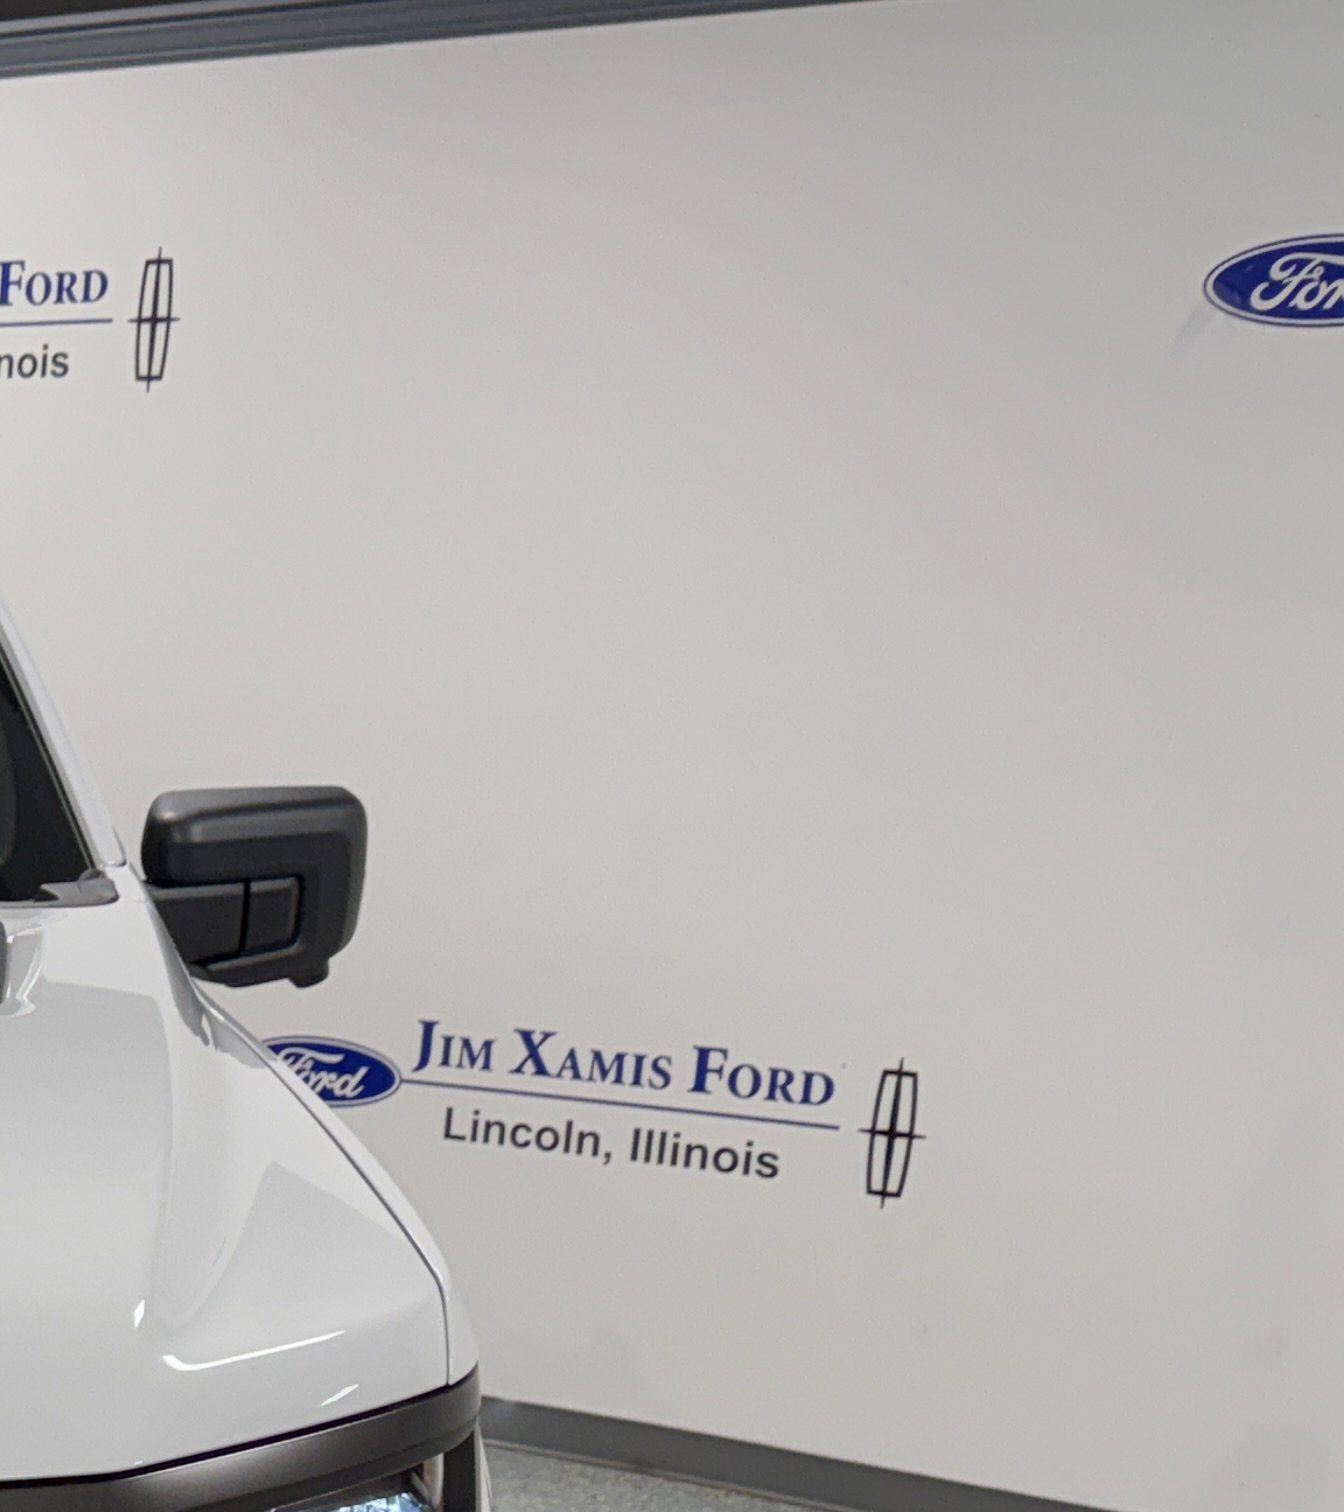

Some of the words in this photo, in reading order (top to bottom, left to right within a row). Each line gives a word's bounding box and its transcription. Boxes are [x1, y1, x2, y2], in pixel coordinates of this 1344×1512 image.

[1250, 252, 1344, 311] For
[412, 1019, 495, 1073] JIM
[508, 1028, 673, 1091] XAMIS
[686, 1045, 835, 1106] FORD
[443, 1106, 613, 1165] Lincoln,
[630, 1127, 781, 1179] Illinois
